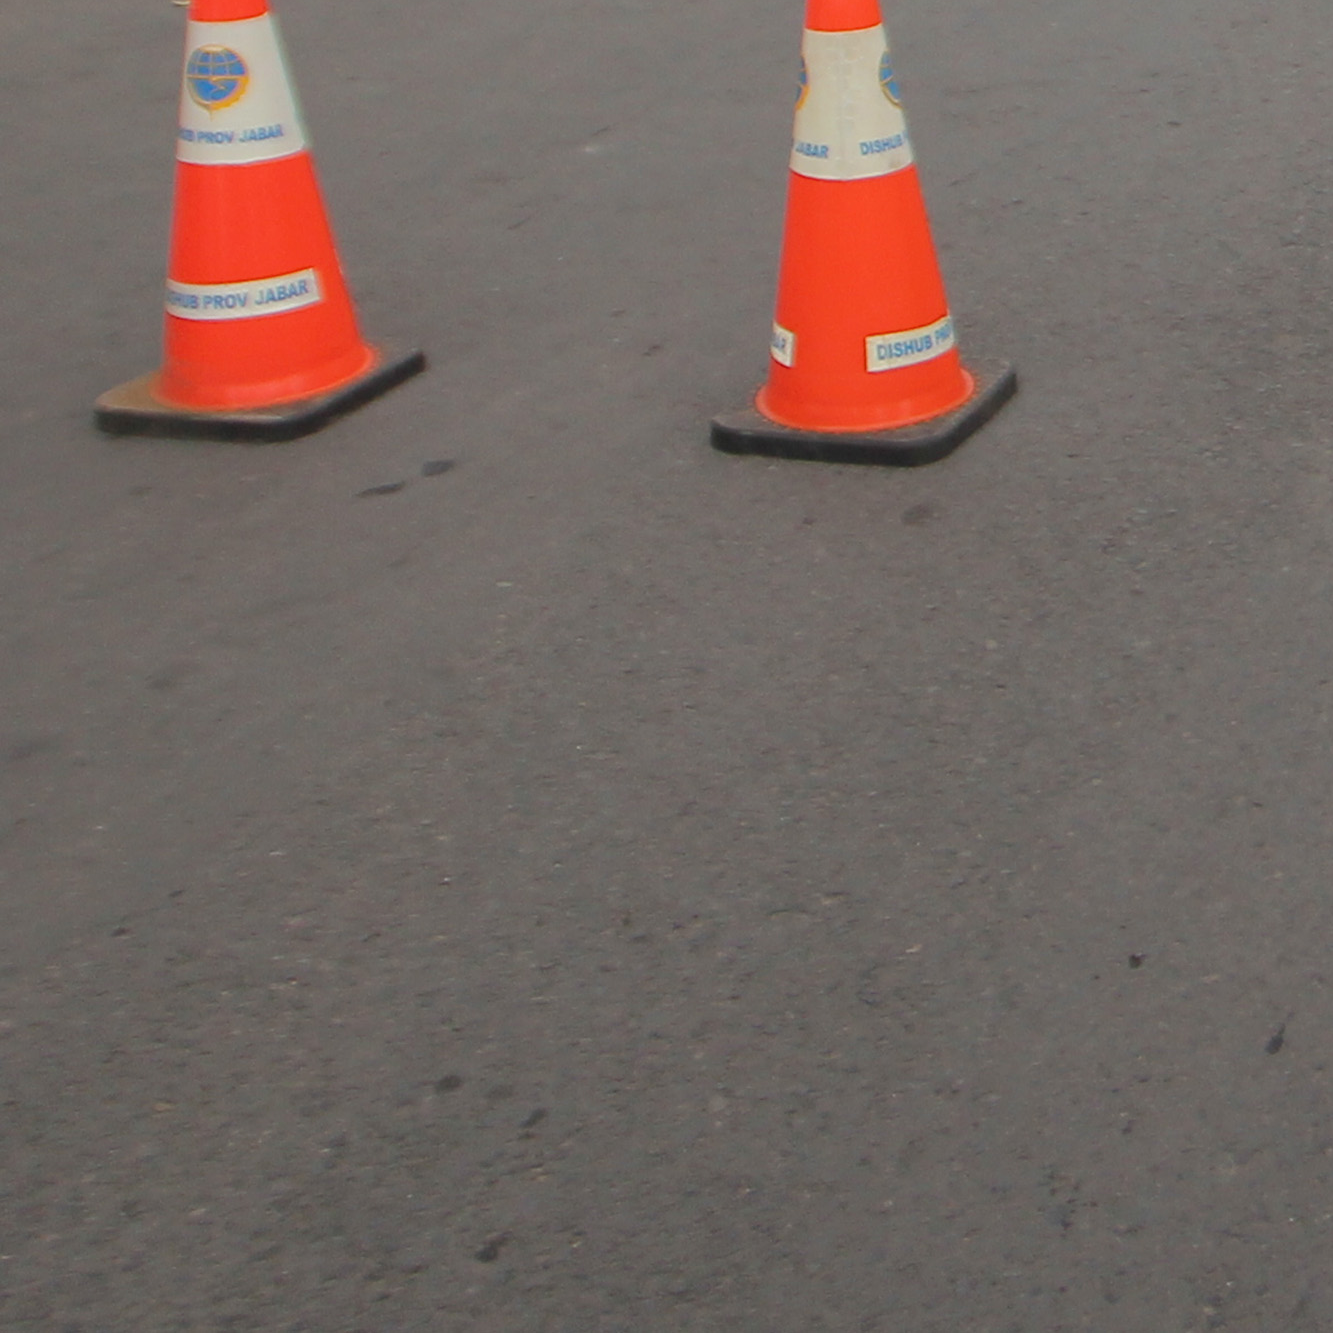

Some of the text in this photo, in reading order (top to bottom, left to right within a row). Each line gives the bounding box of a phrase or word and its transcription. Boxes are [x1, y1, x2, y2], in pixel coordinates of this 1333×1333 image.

[197, 131, 234, 144] PROV
[239, 124, 284, 143] JABAR
[859, 133, 904, 156] DISHUB
[202, 292, 249, 309] PROV
[254, 279, 309, 305] JABAR
[876, 334, 934, 361] DISHUB
